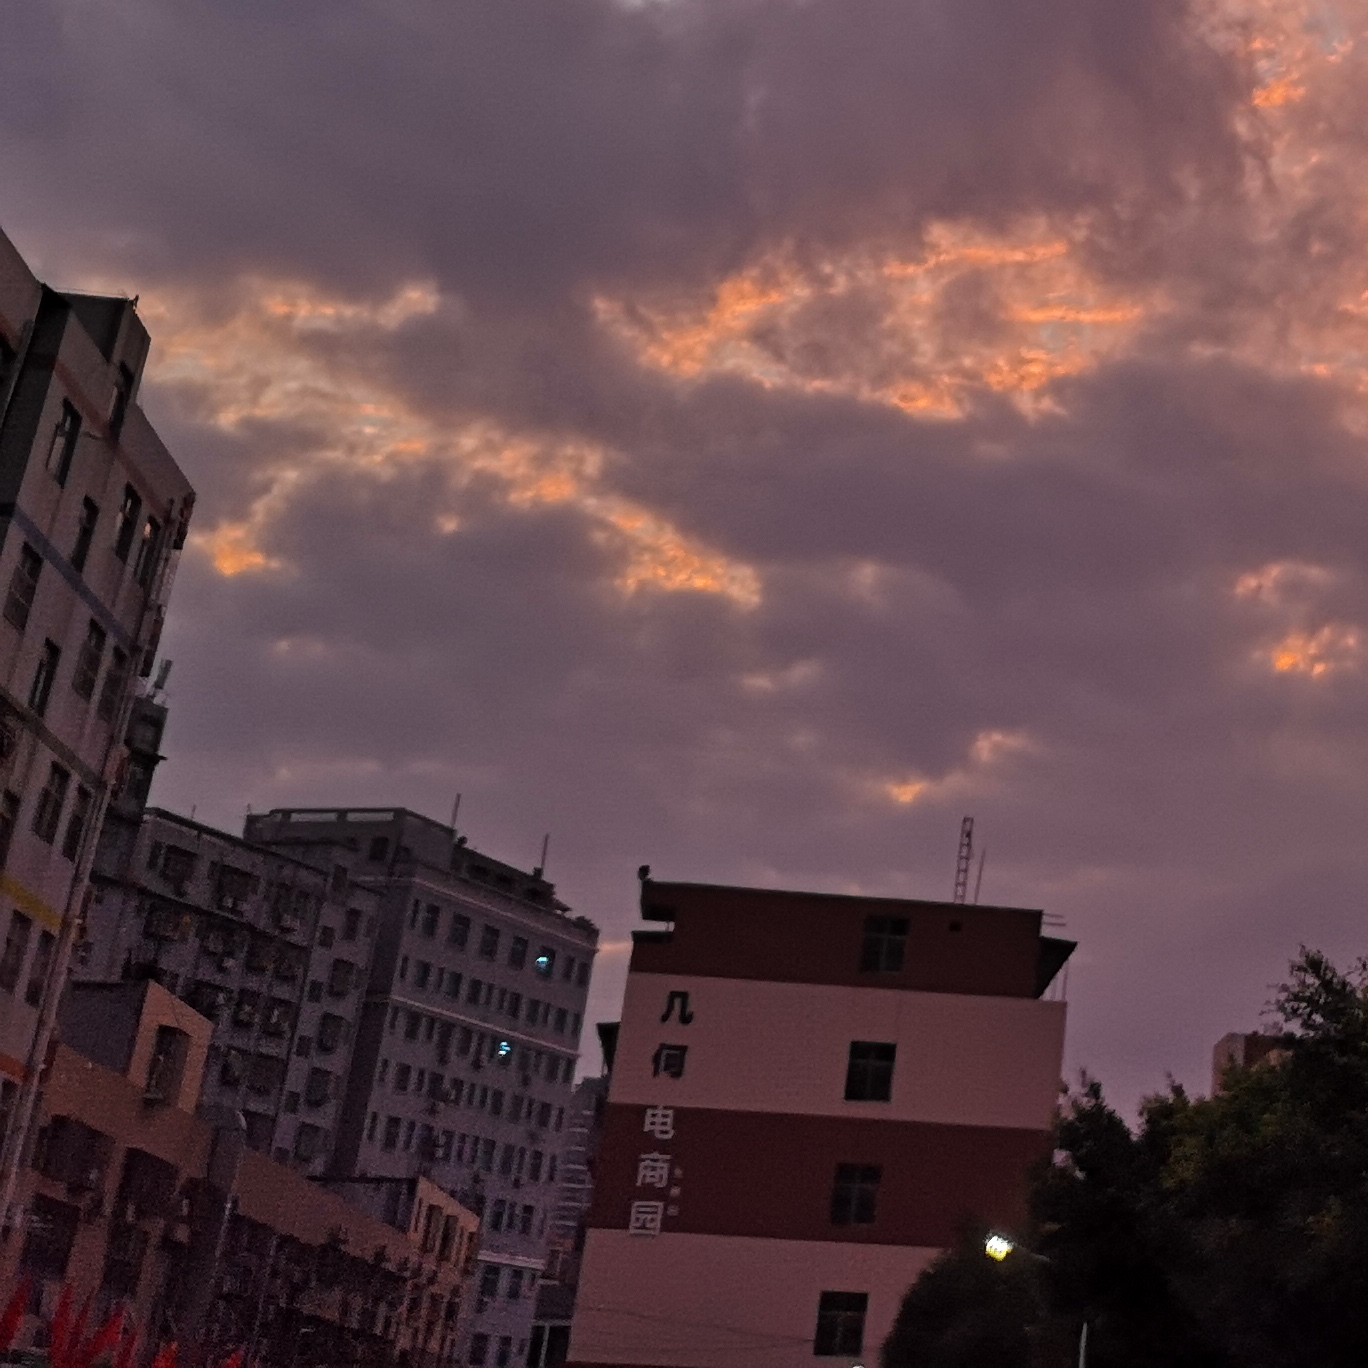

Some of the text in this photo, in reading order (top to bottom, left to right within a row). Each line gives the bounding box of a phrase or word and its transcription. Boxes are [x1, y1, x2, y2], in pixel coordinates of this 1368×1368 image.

[629, 990, 694, 1235] 几何电商园
